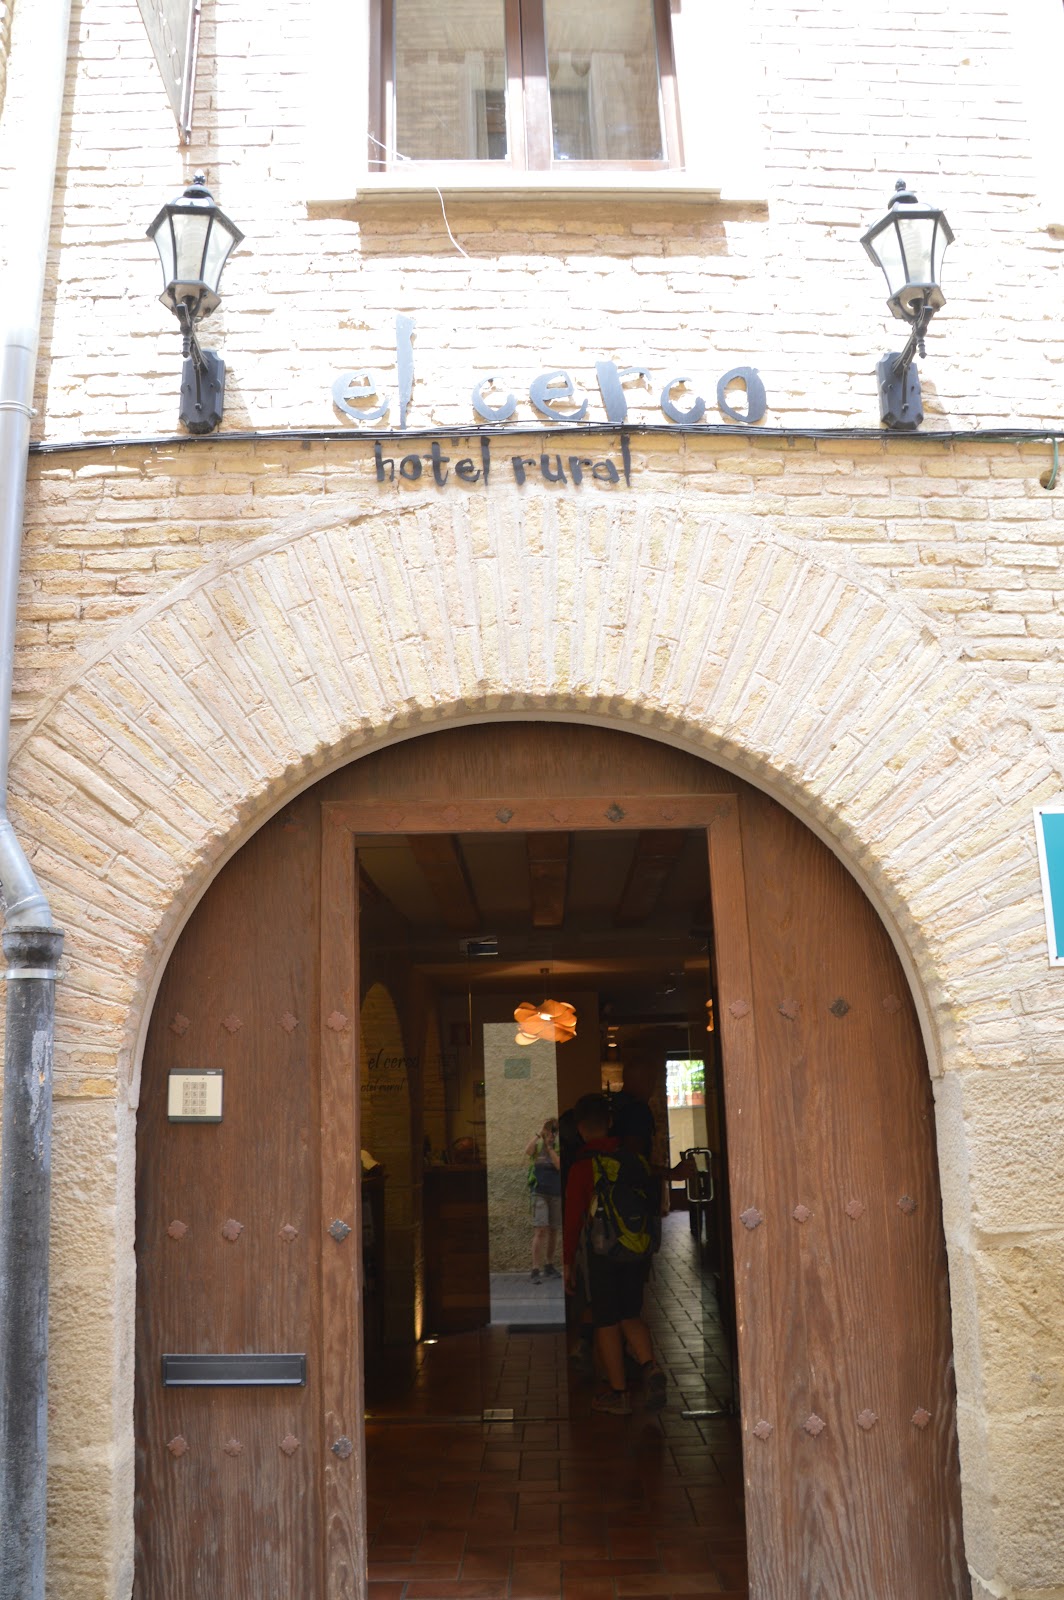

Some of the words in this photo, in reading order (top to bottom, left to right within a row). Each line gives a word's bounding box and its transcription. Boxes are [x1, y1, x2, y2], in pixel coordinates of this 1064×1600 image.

[332, 314, 415, 430] el
[472, 360, 767, 424] cerco
[374, 436, 490, 487] hotel
[511, 434, 631, 487] rural
